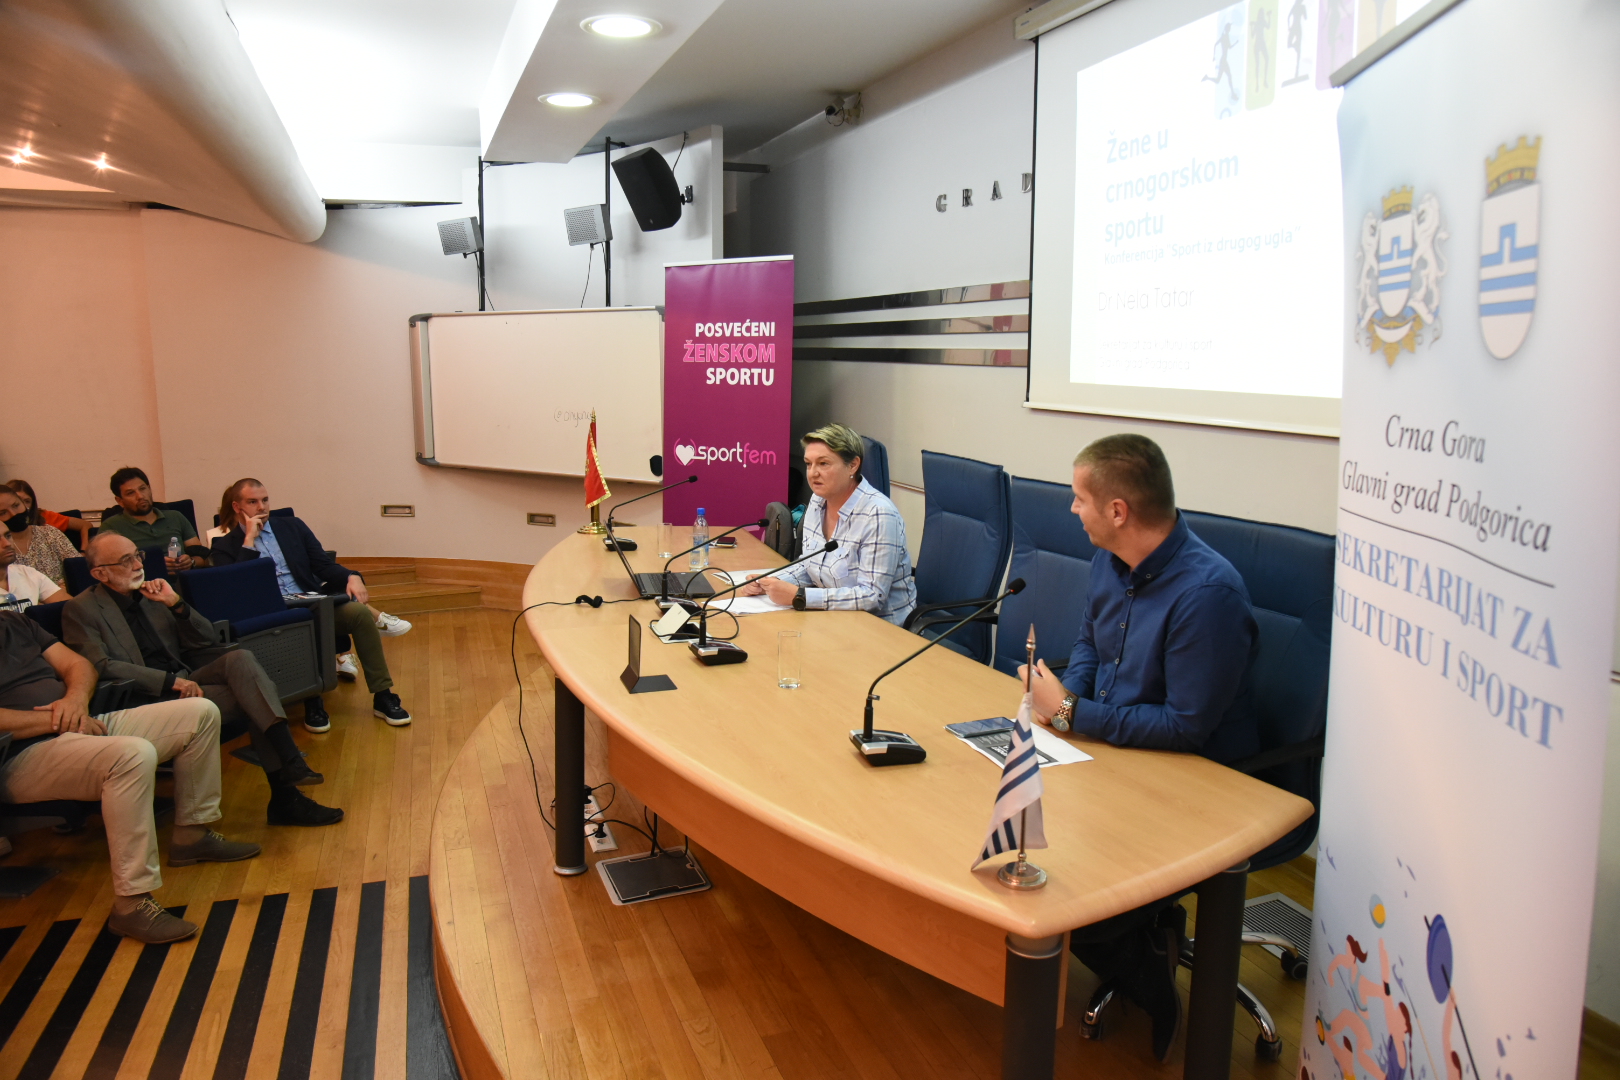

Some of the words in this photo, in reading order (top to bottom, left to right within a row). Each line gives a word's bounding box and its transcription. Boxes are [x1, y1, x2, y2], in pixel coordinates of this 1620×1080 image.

[1106, 129, 1152, 164] Žene
[1157, 128, 1169, 150] u
[936, 173, 1032, 212] GRAD
[1105, 155, 1239, 203] crnogorskom
[1104, 211, 1165, 248] sportu
[1104, 246, 1165, 266] Konferencija
[1203, 238, 1213, 253] iz
[1216, 233, 1262, 255] drugog
[1098, 291, 1113, 311] Dr
[1116, 288, 1149, 310] Nela
[1154, 286, 1195, 308] Tatar
[695, 319, 775, 337] POSVEĆENI
[683, 339, 776, 363] ŽENSKOM
[706, 367, 775, 386] SPORTU
[698, 442, 777, 467] sportfem
[1385, 414, 1434, 453] Crna
[1441, 420, 1487, 464] Gora
[1342, 460, 1389, 501] Glavni
[1391, 479, 1443, 514] grad
[1445, 483, 1552, 553] Podgorica
[1335, 528, 1505, 640] SEKRETARIJAT
[1510, 605, 1562, 670] ZA
[1440, 638, 1452, 680] I
[1456, 650, 1565, 750] SPORT
